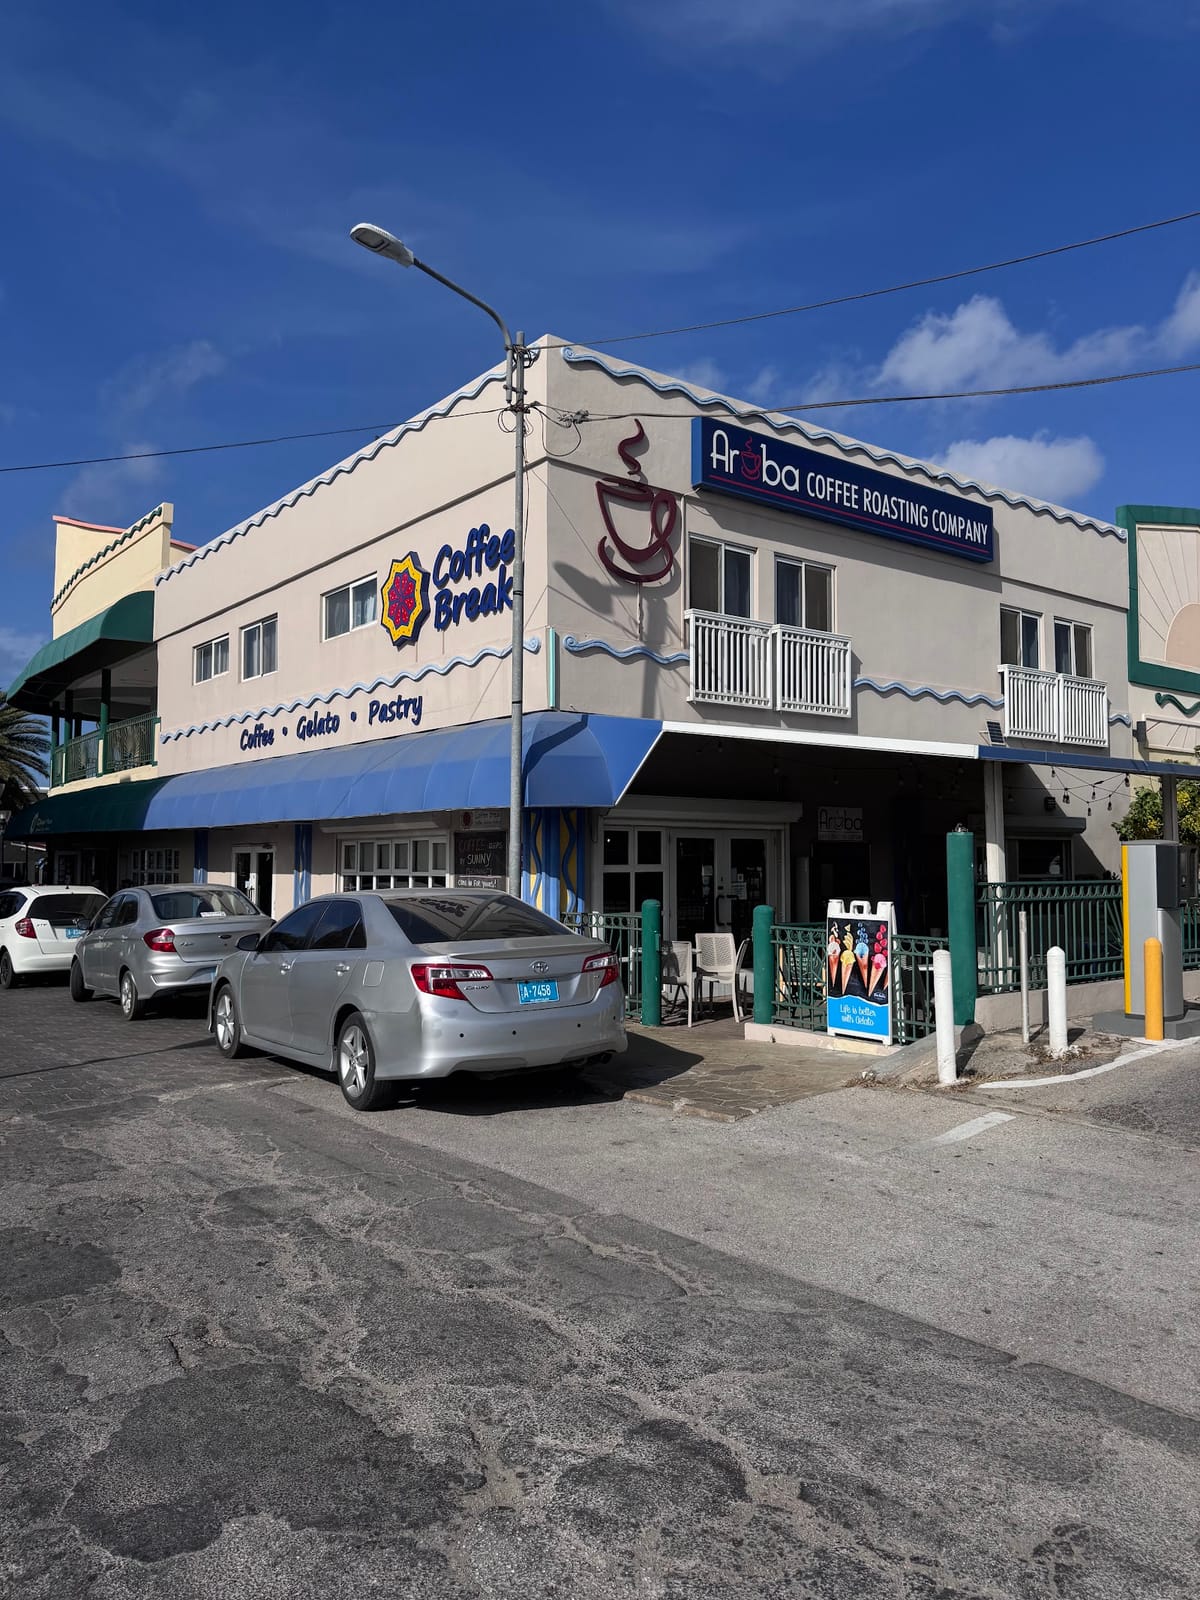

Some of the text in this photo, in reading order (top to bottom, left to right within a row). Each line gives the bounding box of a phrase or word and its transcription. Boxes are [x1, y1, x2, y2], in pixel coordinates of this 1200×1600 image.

[806, 471, 860, 509] COFFEE
[863, 488, 929, 528] ROASTING
[932, 509, 988, 545] COMPANY
[433, 523, 515, 590] Coffee
[434, 563, 514, 632] Break
[240, 695, 423, 751] Coffee Gelato Pastry
[840, 1003, 877, 1017] Life is better
[841, 1014, 875, 1027] with Gelato
